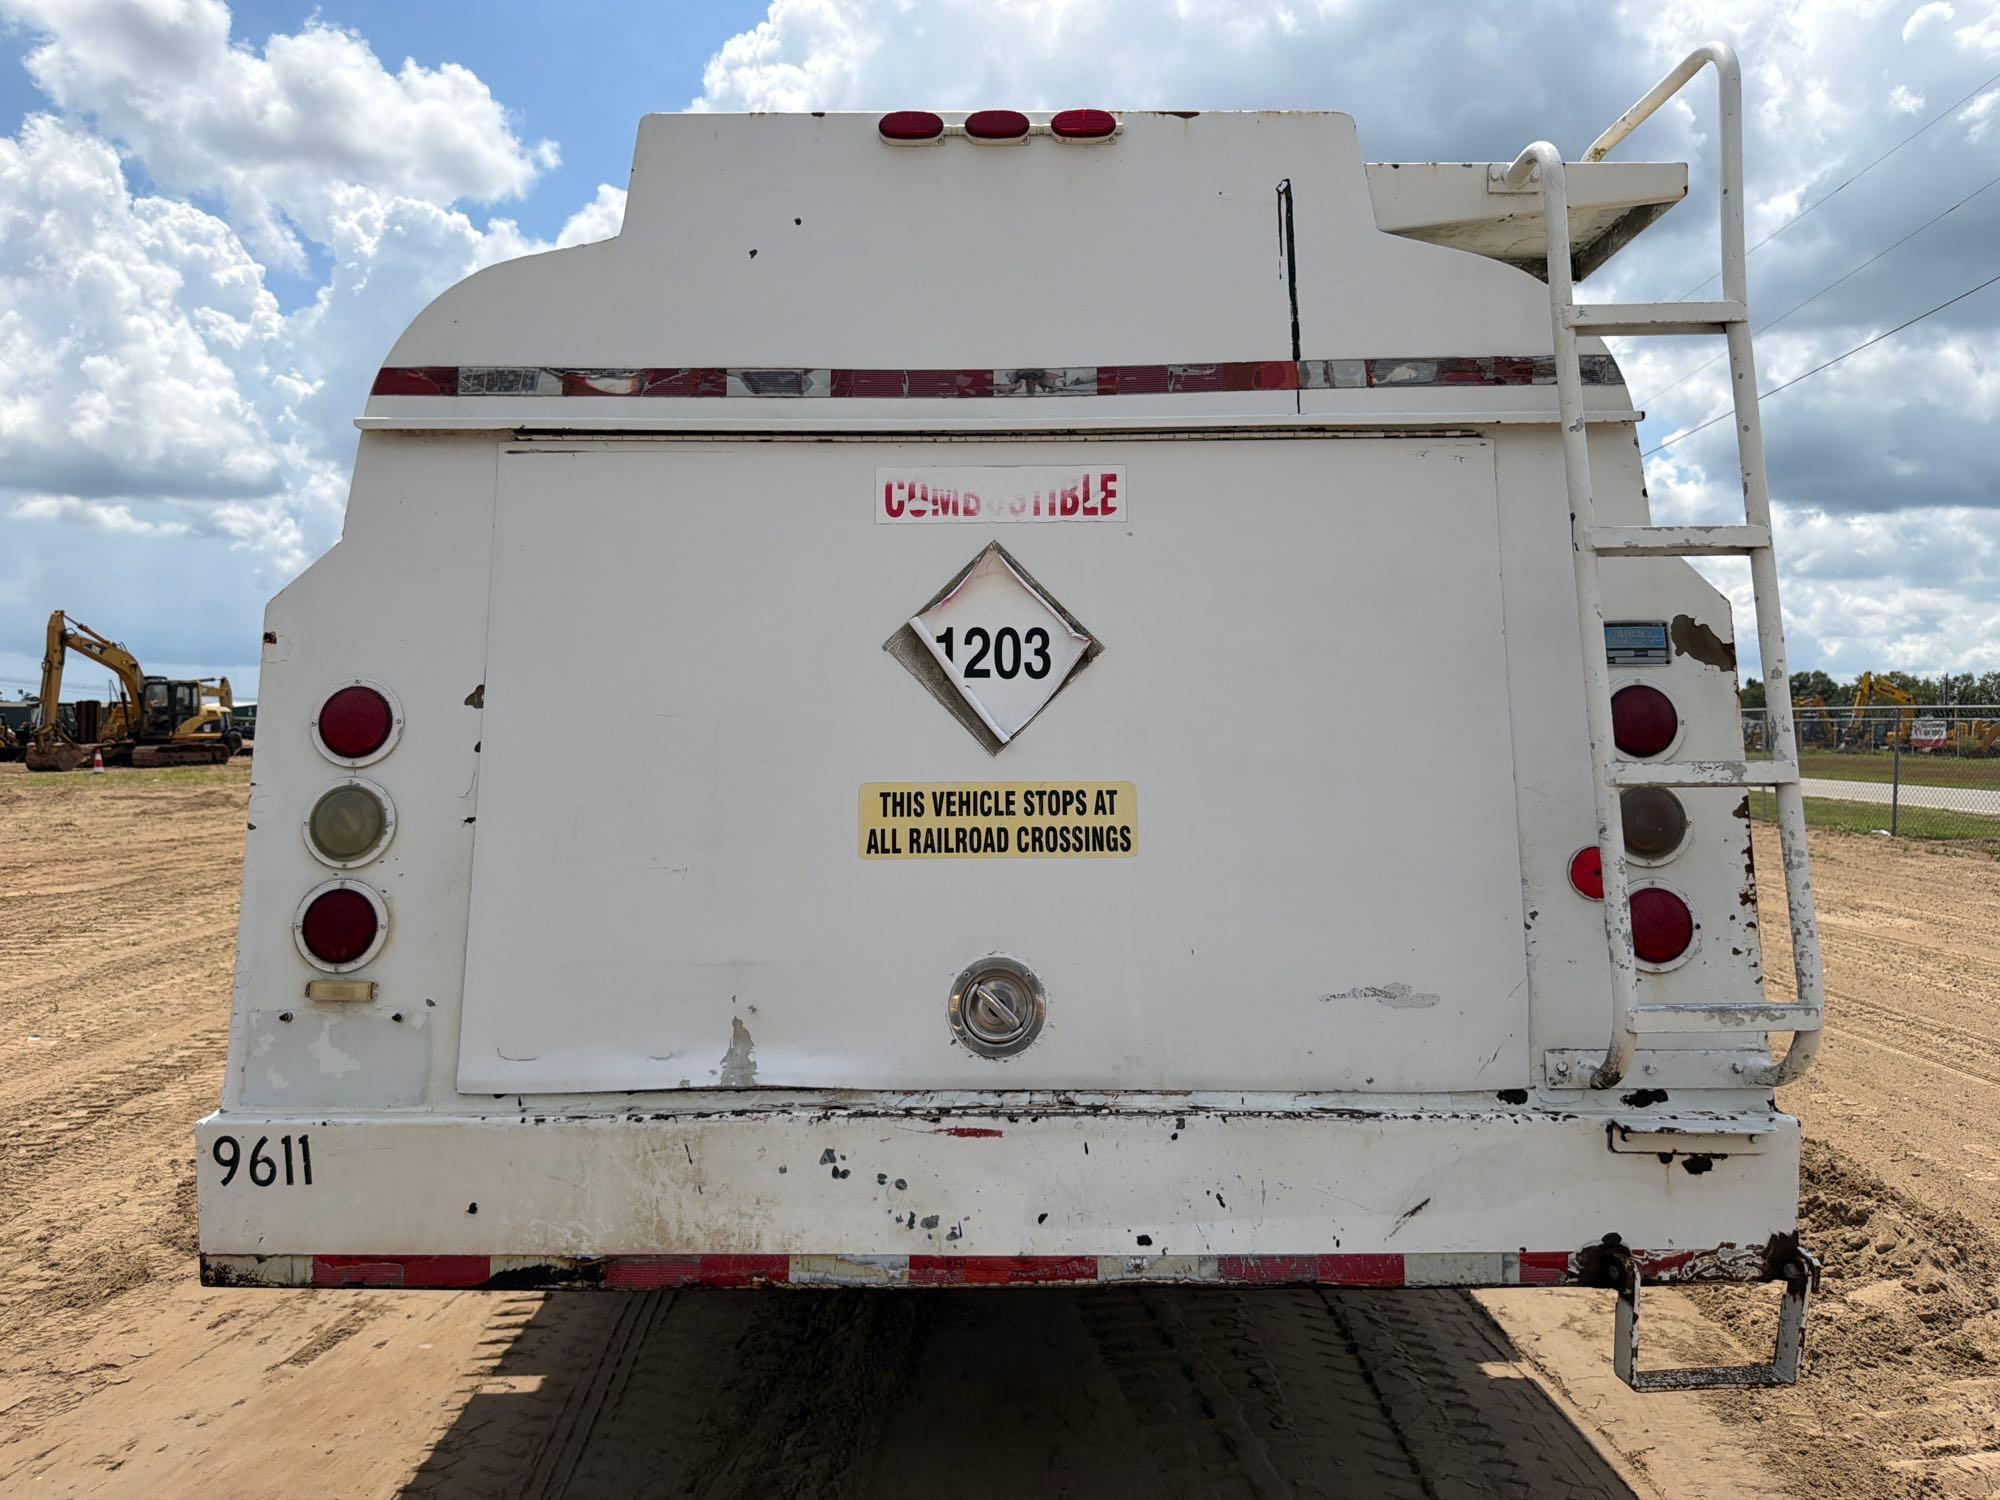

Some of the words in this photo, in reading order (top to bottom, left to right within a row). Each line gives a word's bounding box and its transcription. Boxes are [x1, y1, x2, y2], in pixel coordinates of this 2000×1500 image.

[936, 626, 1051, 680] 1203
[880, 791, 925, 817] THIS
[932, 791, 1016, 817] VEHICLE
[1023, 789, 1087, 816] STOPS
[1094, 789, 1118, 816] AT
[866, 828, 902, 854] ALL
[909, 827, 1009, 854] RAILROAD
[1016, 825, 1131, 853] CROSSINGS
[212, 1134, 313, 1187] 9611
